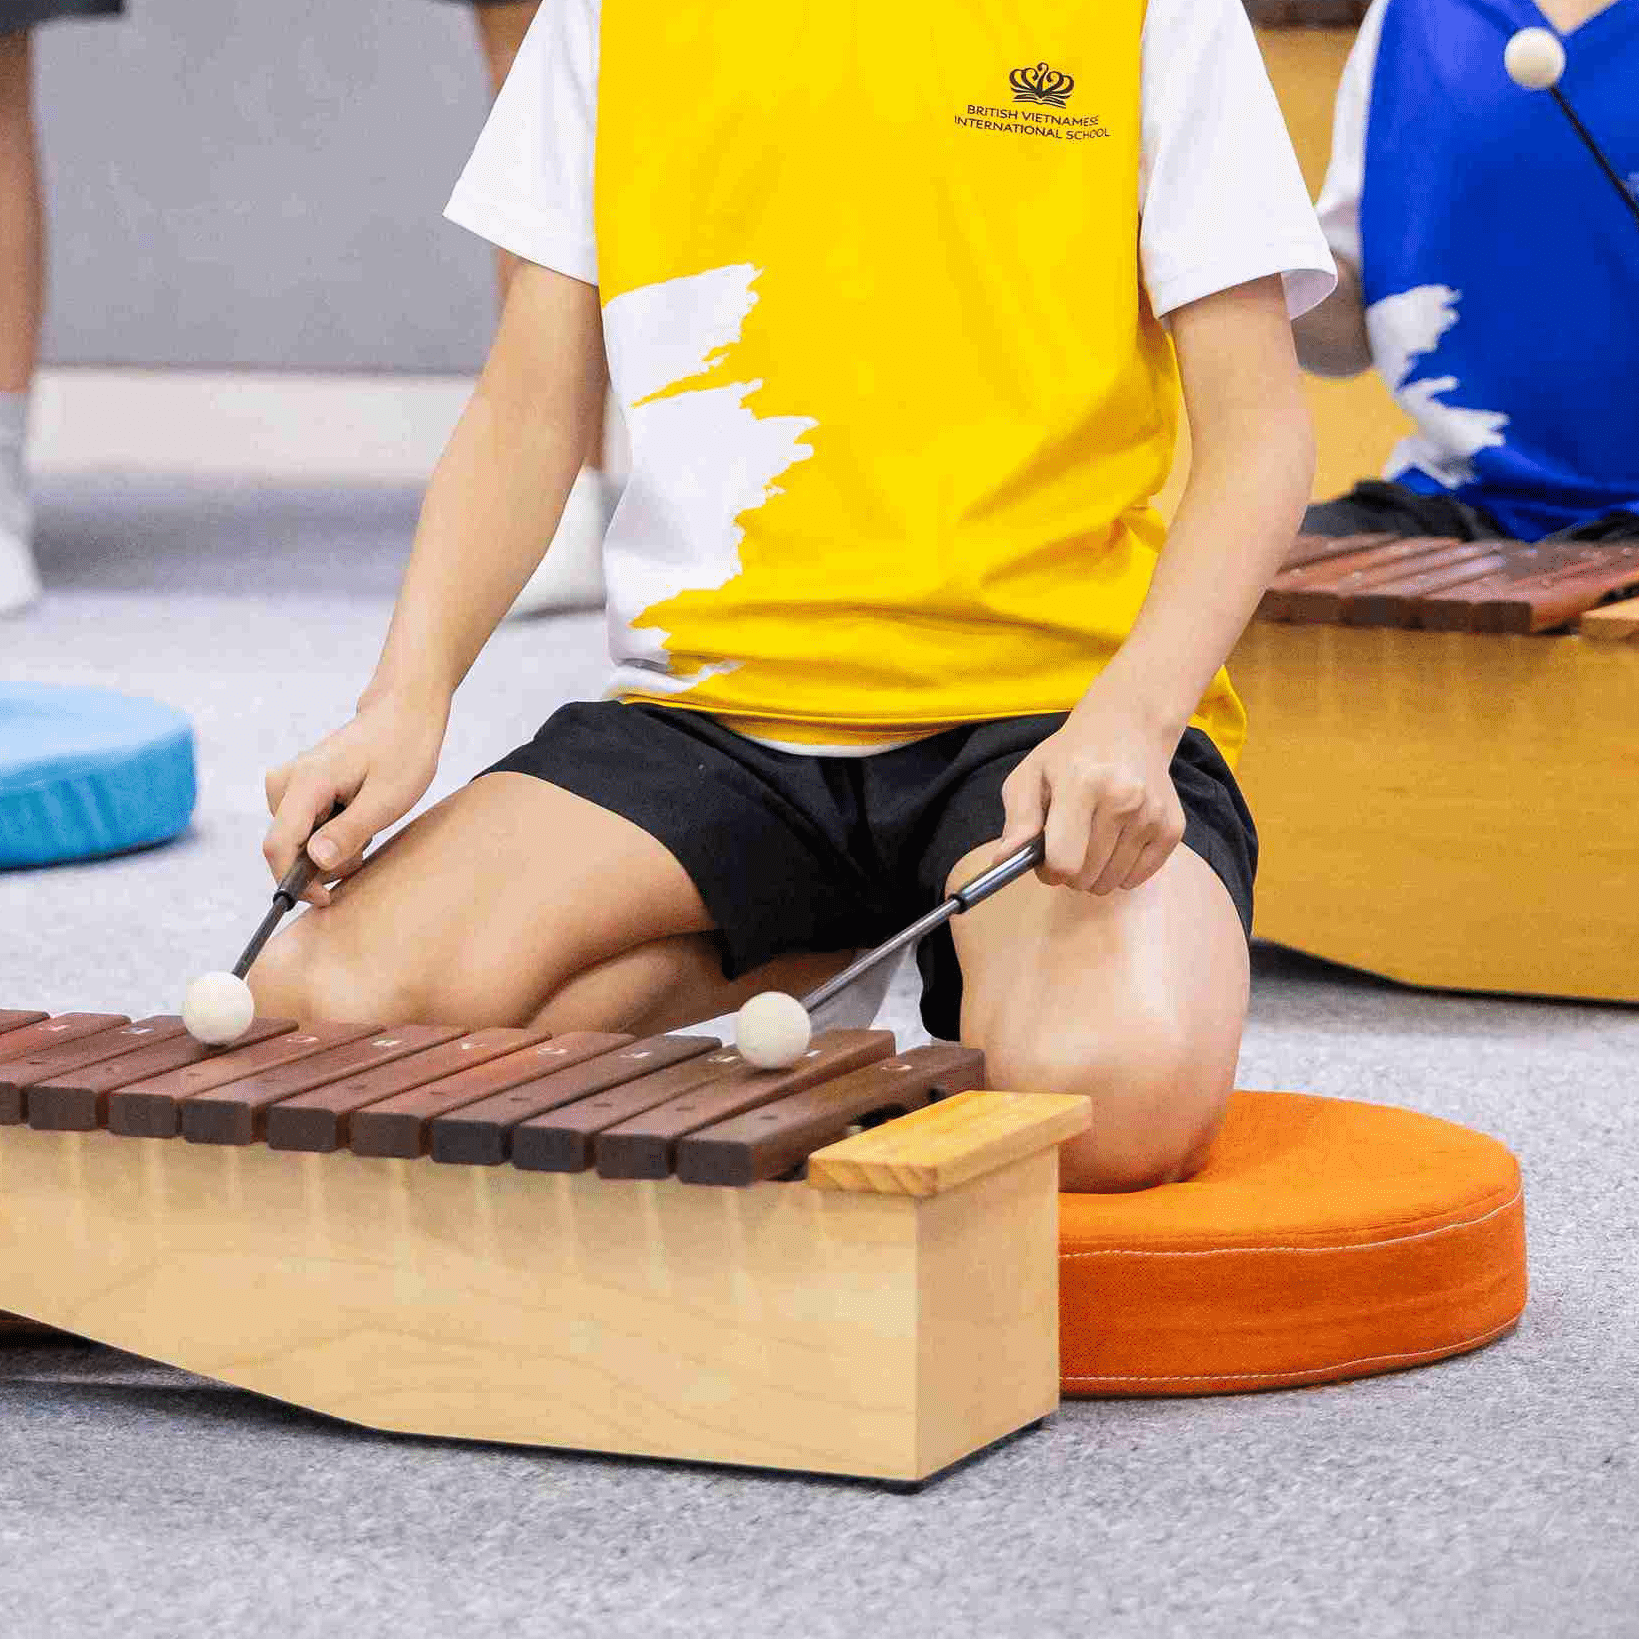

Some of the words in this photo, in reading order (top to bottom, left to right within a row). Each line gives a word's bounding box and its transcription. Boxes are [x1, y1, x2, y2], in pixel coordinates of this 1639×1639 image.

[954, 114, 1063, 140] INTERNATIONAL
[1065, 127, 1111, 141] SCHOOL
[967, 104, 1019, 121] BRITISH
[1021, 110, 1099, 128] VIETNAMESE
